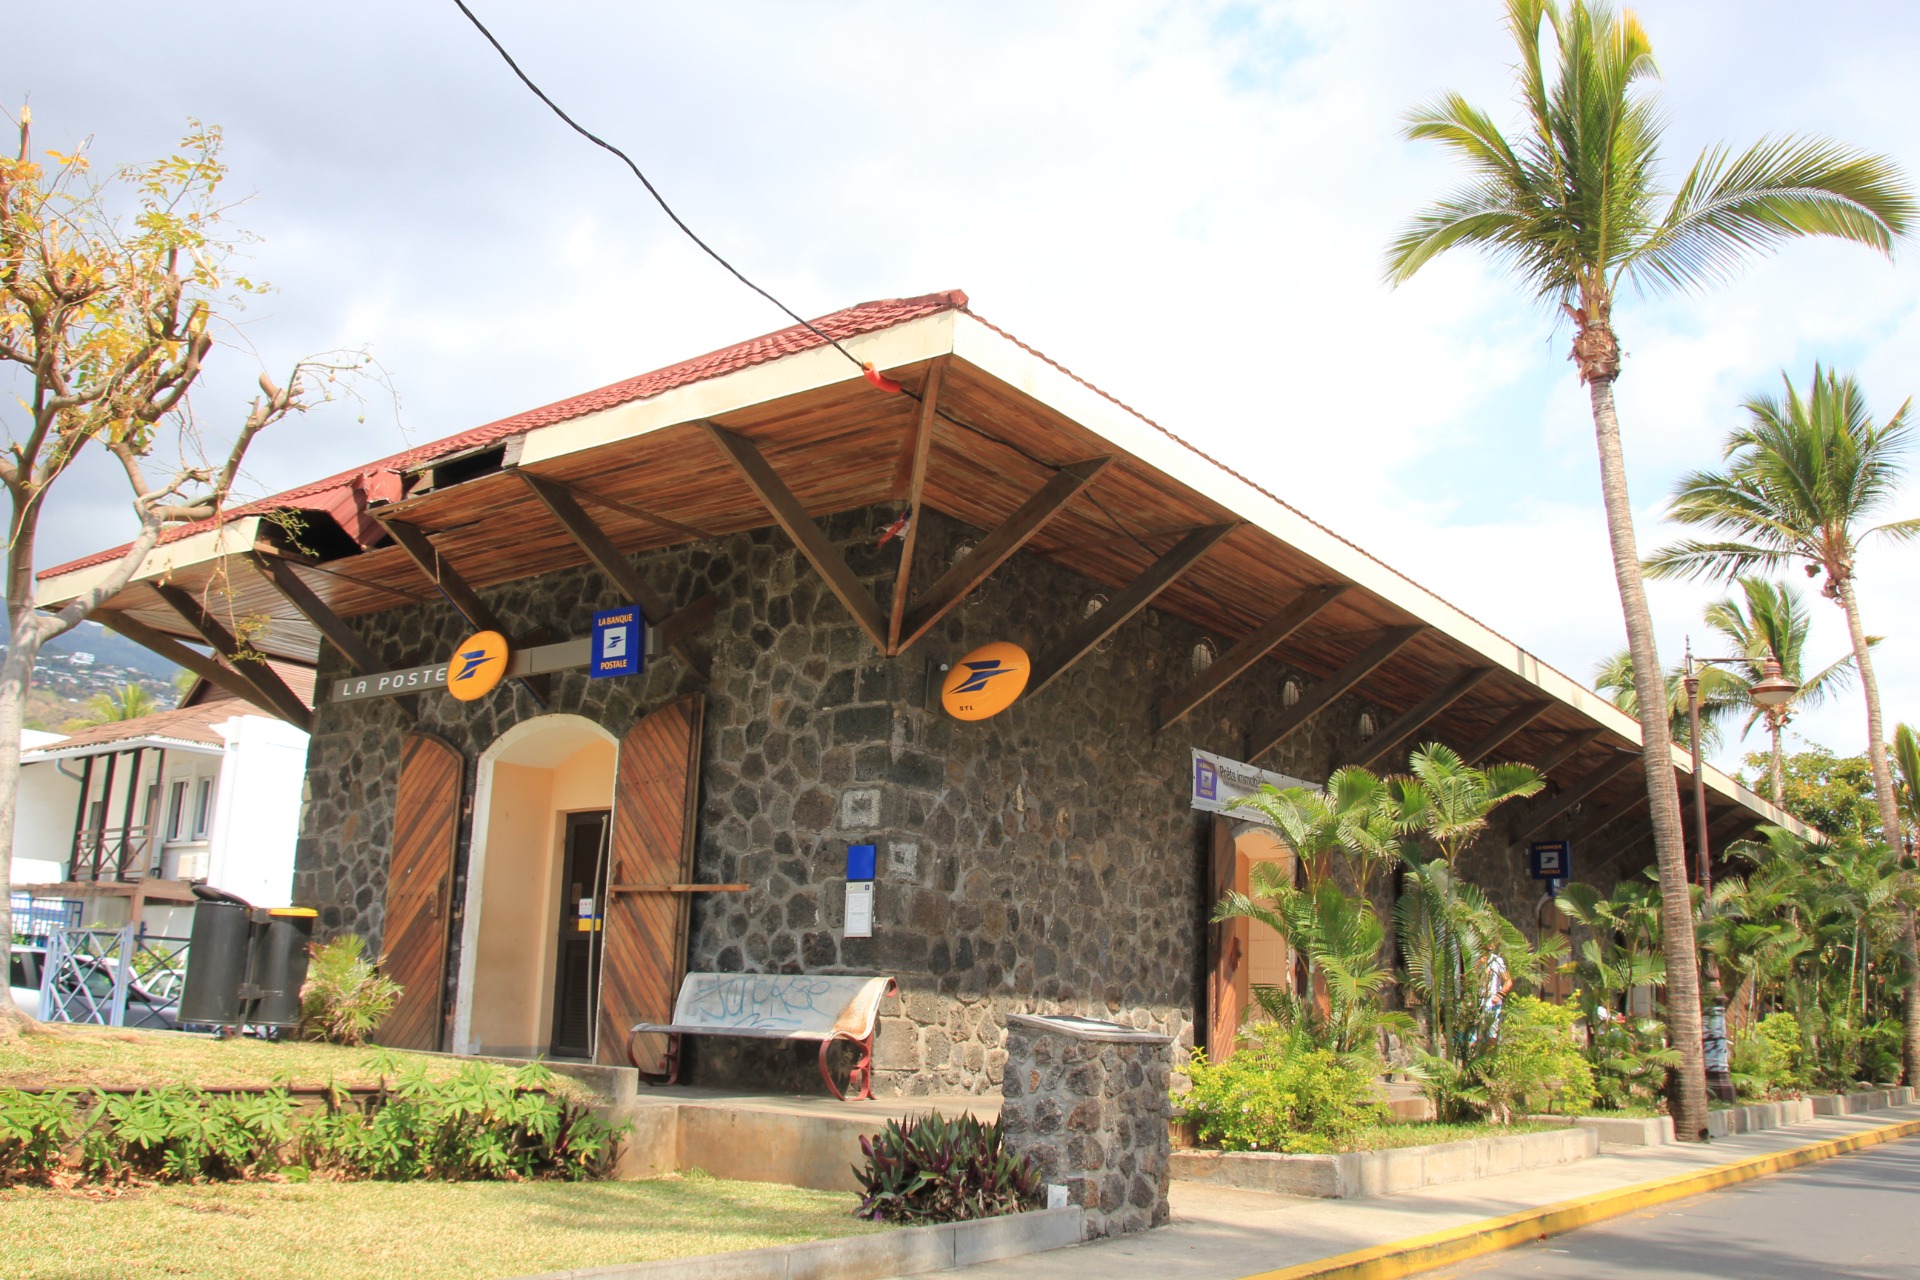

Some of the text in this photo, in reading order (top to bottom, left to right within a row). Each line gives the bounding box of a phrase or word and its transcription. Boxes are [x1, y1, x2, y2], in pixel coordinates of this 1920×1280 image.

[598, 613, 633, 627] LA BANQUE
[600, 659, 628, 670] POSTALE
[342, 667, 448, 696] LA POSTE
[1219, 765, 1237, 783] Prêts
